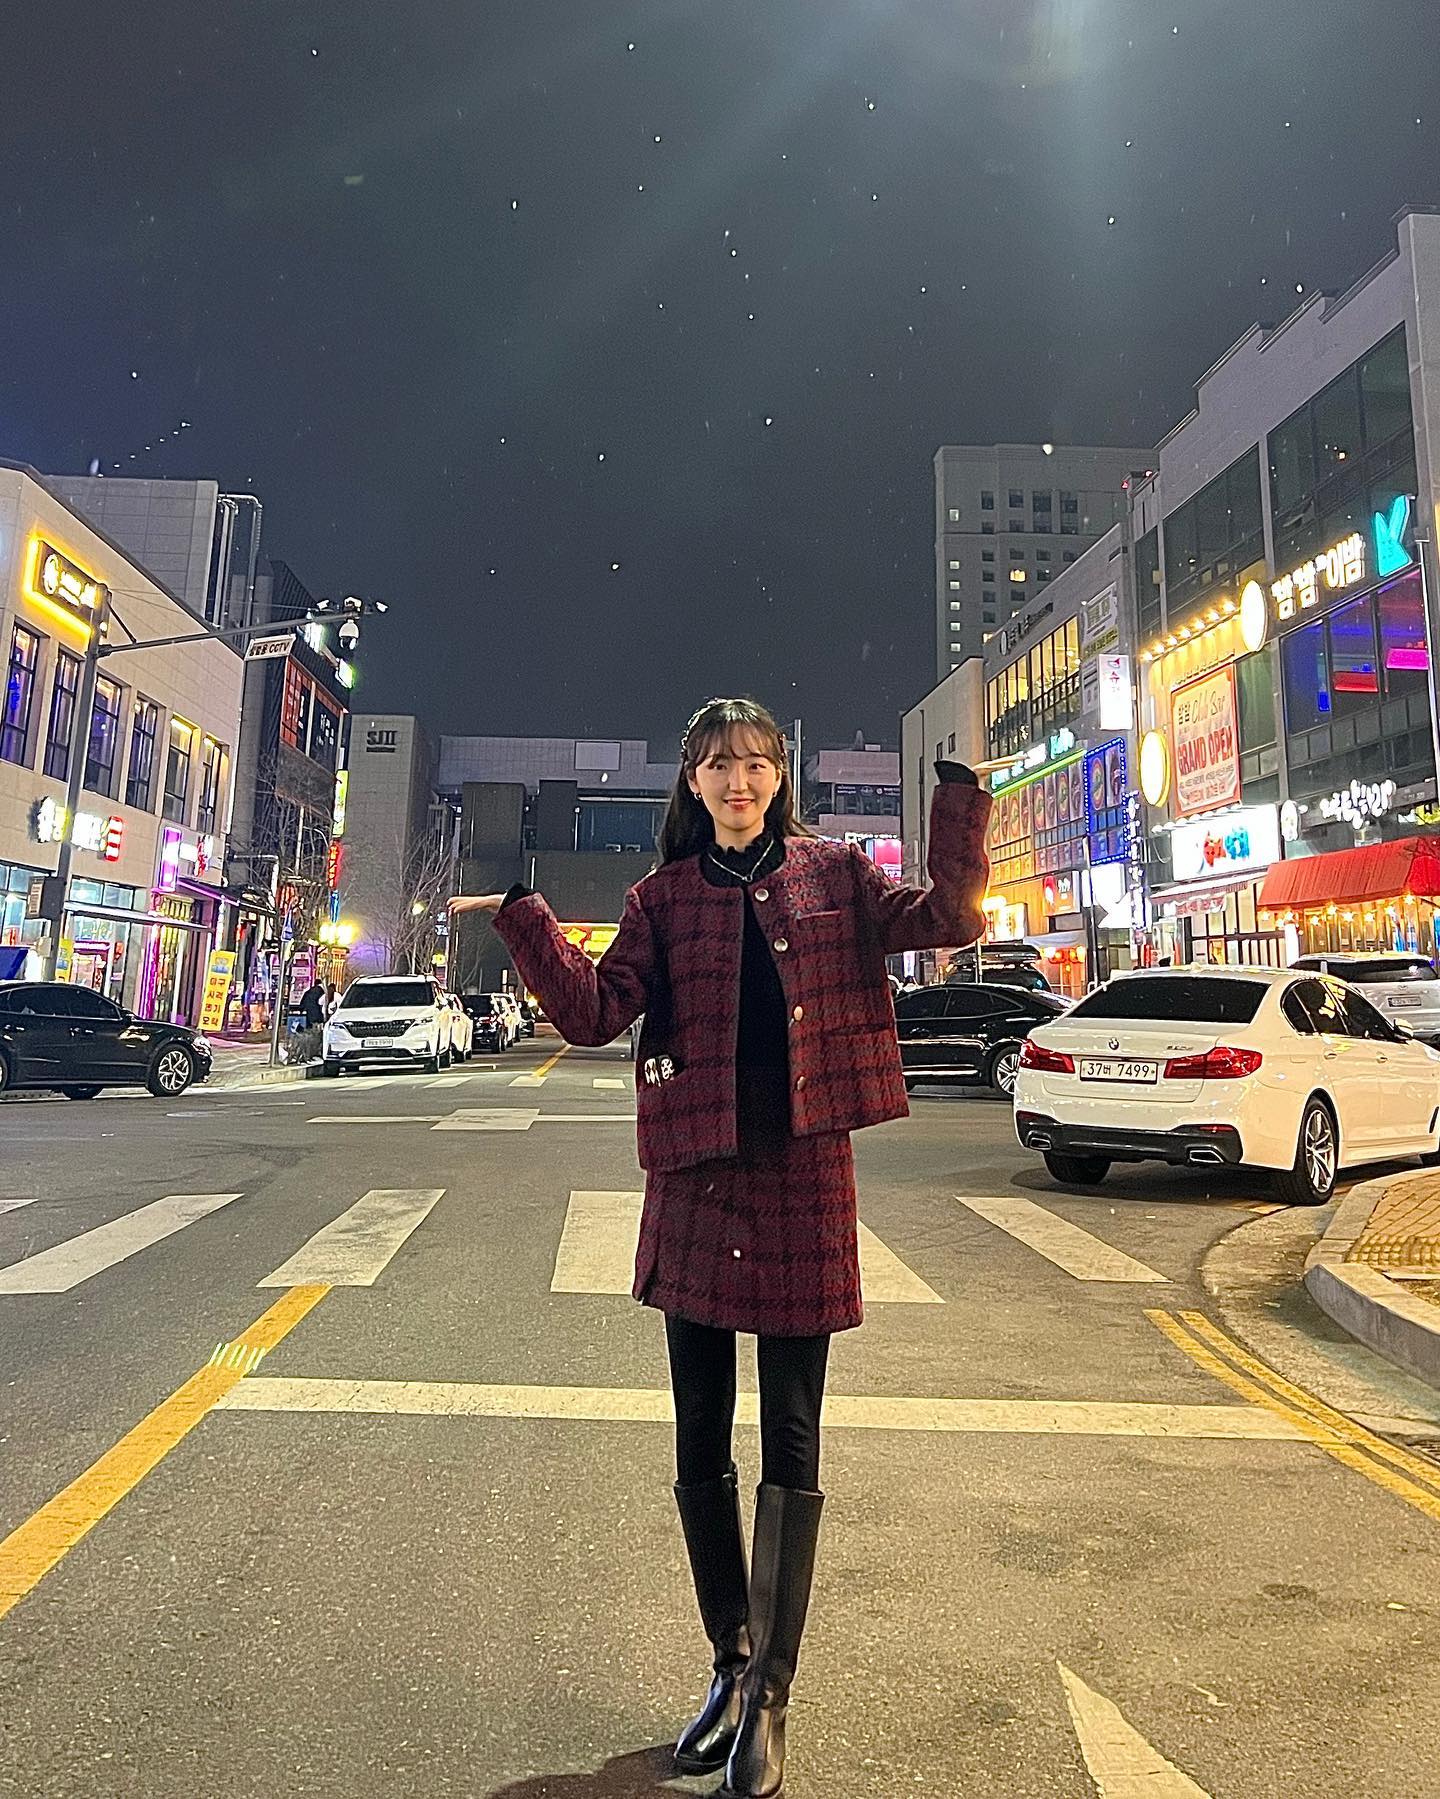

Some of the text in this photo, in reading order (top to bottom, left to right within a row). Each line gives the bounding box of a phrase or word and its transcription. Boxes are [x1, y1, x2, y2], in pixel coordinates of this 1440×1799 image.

[269, 641, 290, 654] CCTV
[1178, 726, 1234, 776] GRAND OPEN
[1087, 1062, 1150, 1078] 37버 7499
